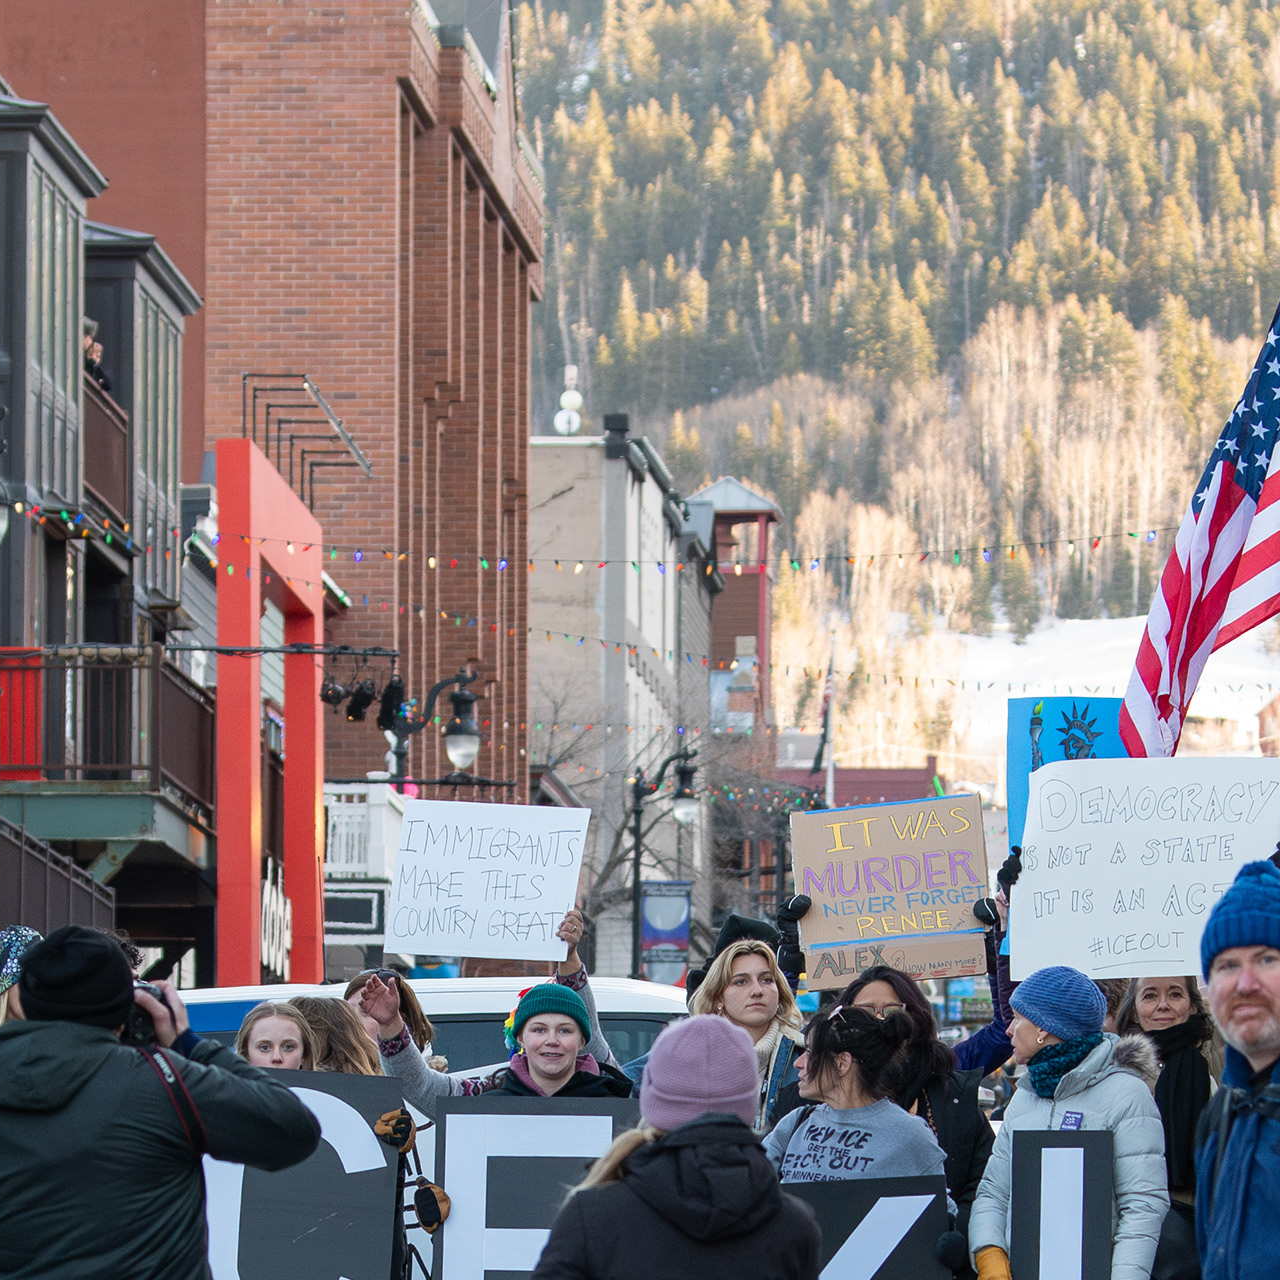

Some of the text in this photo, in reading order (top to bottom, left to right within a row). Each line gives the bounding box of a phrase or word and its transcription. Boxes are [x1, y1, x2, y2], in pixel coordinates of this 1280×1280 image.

[1039, 779, 1280, 832] DEMOCRACY
[399, 820, 582, 867] IMMIGRANTS
[824, 807, 970, 853] IT WAS
[1022, 834, 1235, 871] IS NOT A STATE
[397, 864, 545, 902] MAKE THIS
[803, 850, 980, 898] MURDER
[822, 885, 986, 918] NEVER FORGET
[1033, 890, 1060, 918] IT
[1071, 889, 1094, 914] IS
[1112, 887, 1145, 914] AN
[393, 905, 479, 940] COUNTRY
[856, 910, 952, 937] RENEE
[1088, 931, 1184, 958] #ICEOUT
[813, 945, 889, 979] ALEX
[905, 964, 927, 975] HOW
[929, 961, 953, 970] MANY
[152, 1052, 176, 1083] Canon
[803, 1124, 873, 1149] HEY ICE
[807, 1142, 851, 1157] GET THE
[828, 1156, 874, 1173] OUT
